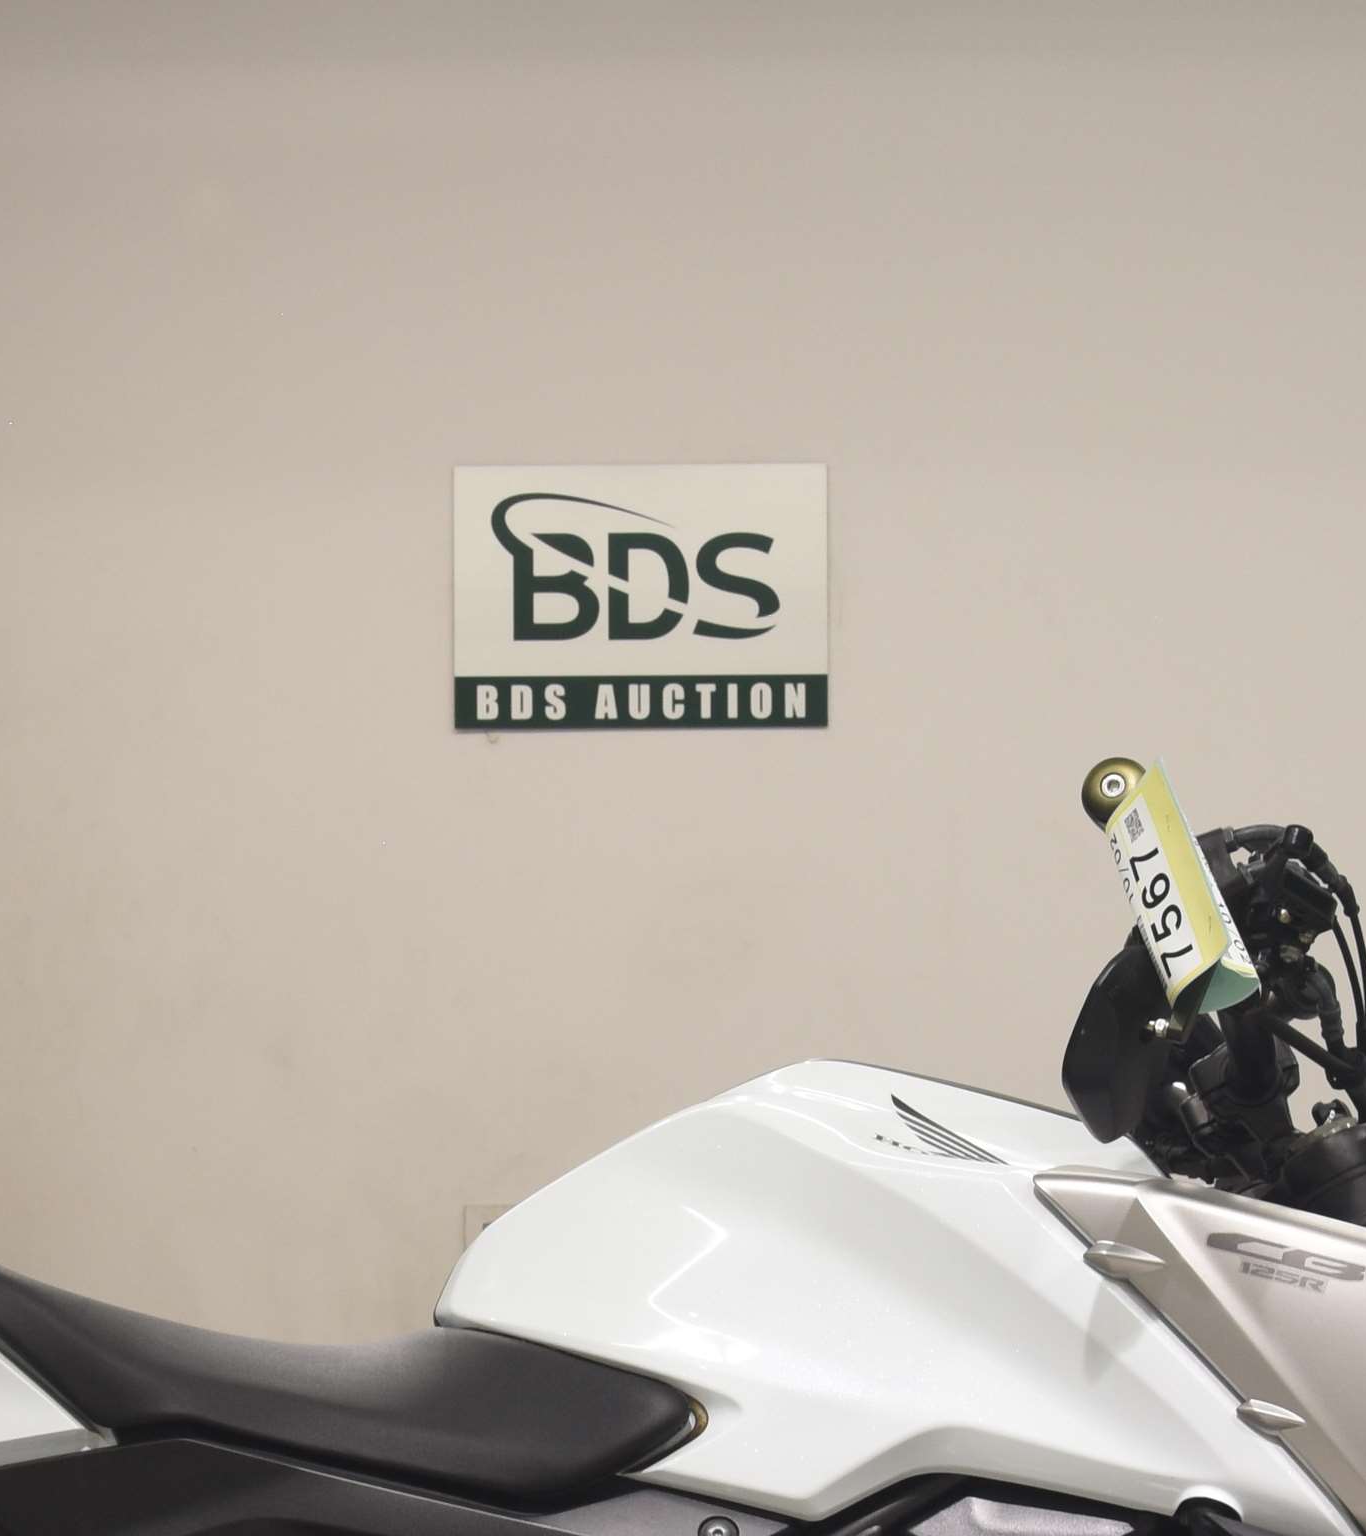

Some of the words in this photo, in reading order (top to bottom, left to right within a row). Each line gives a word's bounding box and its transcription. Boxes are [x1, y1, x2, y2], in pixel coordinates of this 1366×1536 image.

[491, 492, 781, 641] BDS
[475, 684, 567, 721] BDS
[594, 682, 807, 720] AUCTION
[1129, 847, 1194, 979] 7567
[1239, 1260, 1327, 1293] 125R
